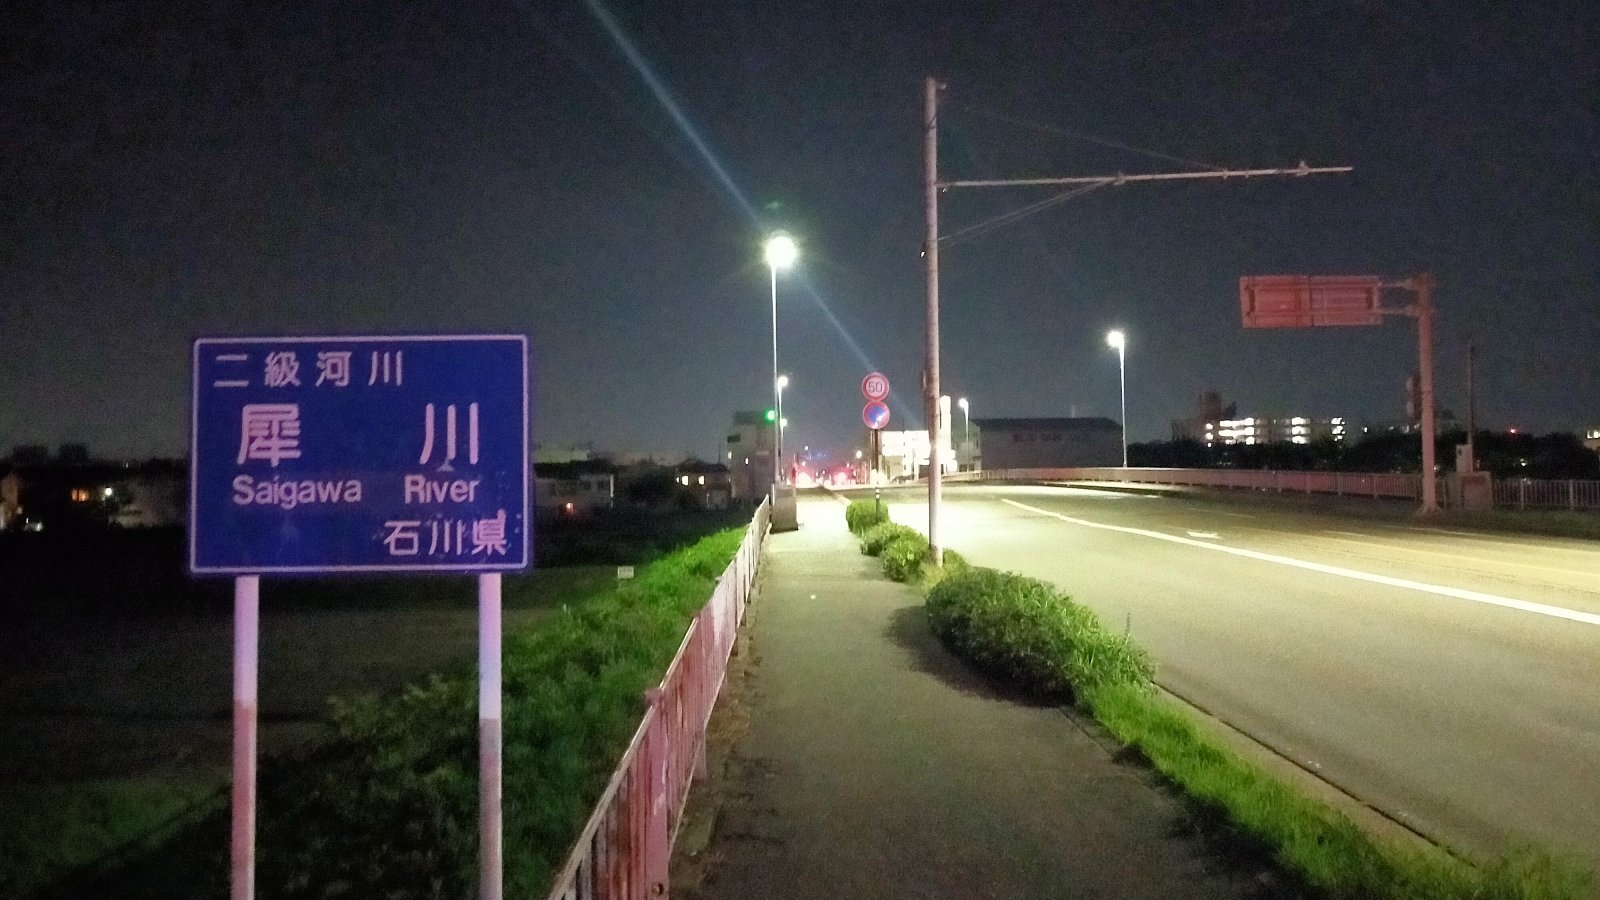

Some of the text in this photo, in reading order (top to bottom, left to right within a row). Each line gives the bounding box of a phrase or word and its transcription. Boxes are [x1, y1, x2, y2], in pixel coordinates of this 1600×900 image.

[214, 350, 403, 388] 二級河川
[868, 381, 883, 393] 50
[232, 474, 480, 510] Saigawa River
[383, 510, 508, 556] 石川県
